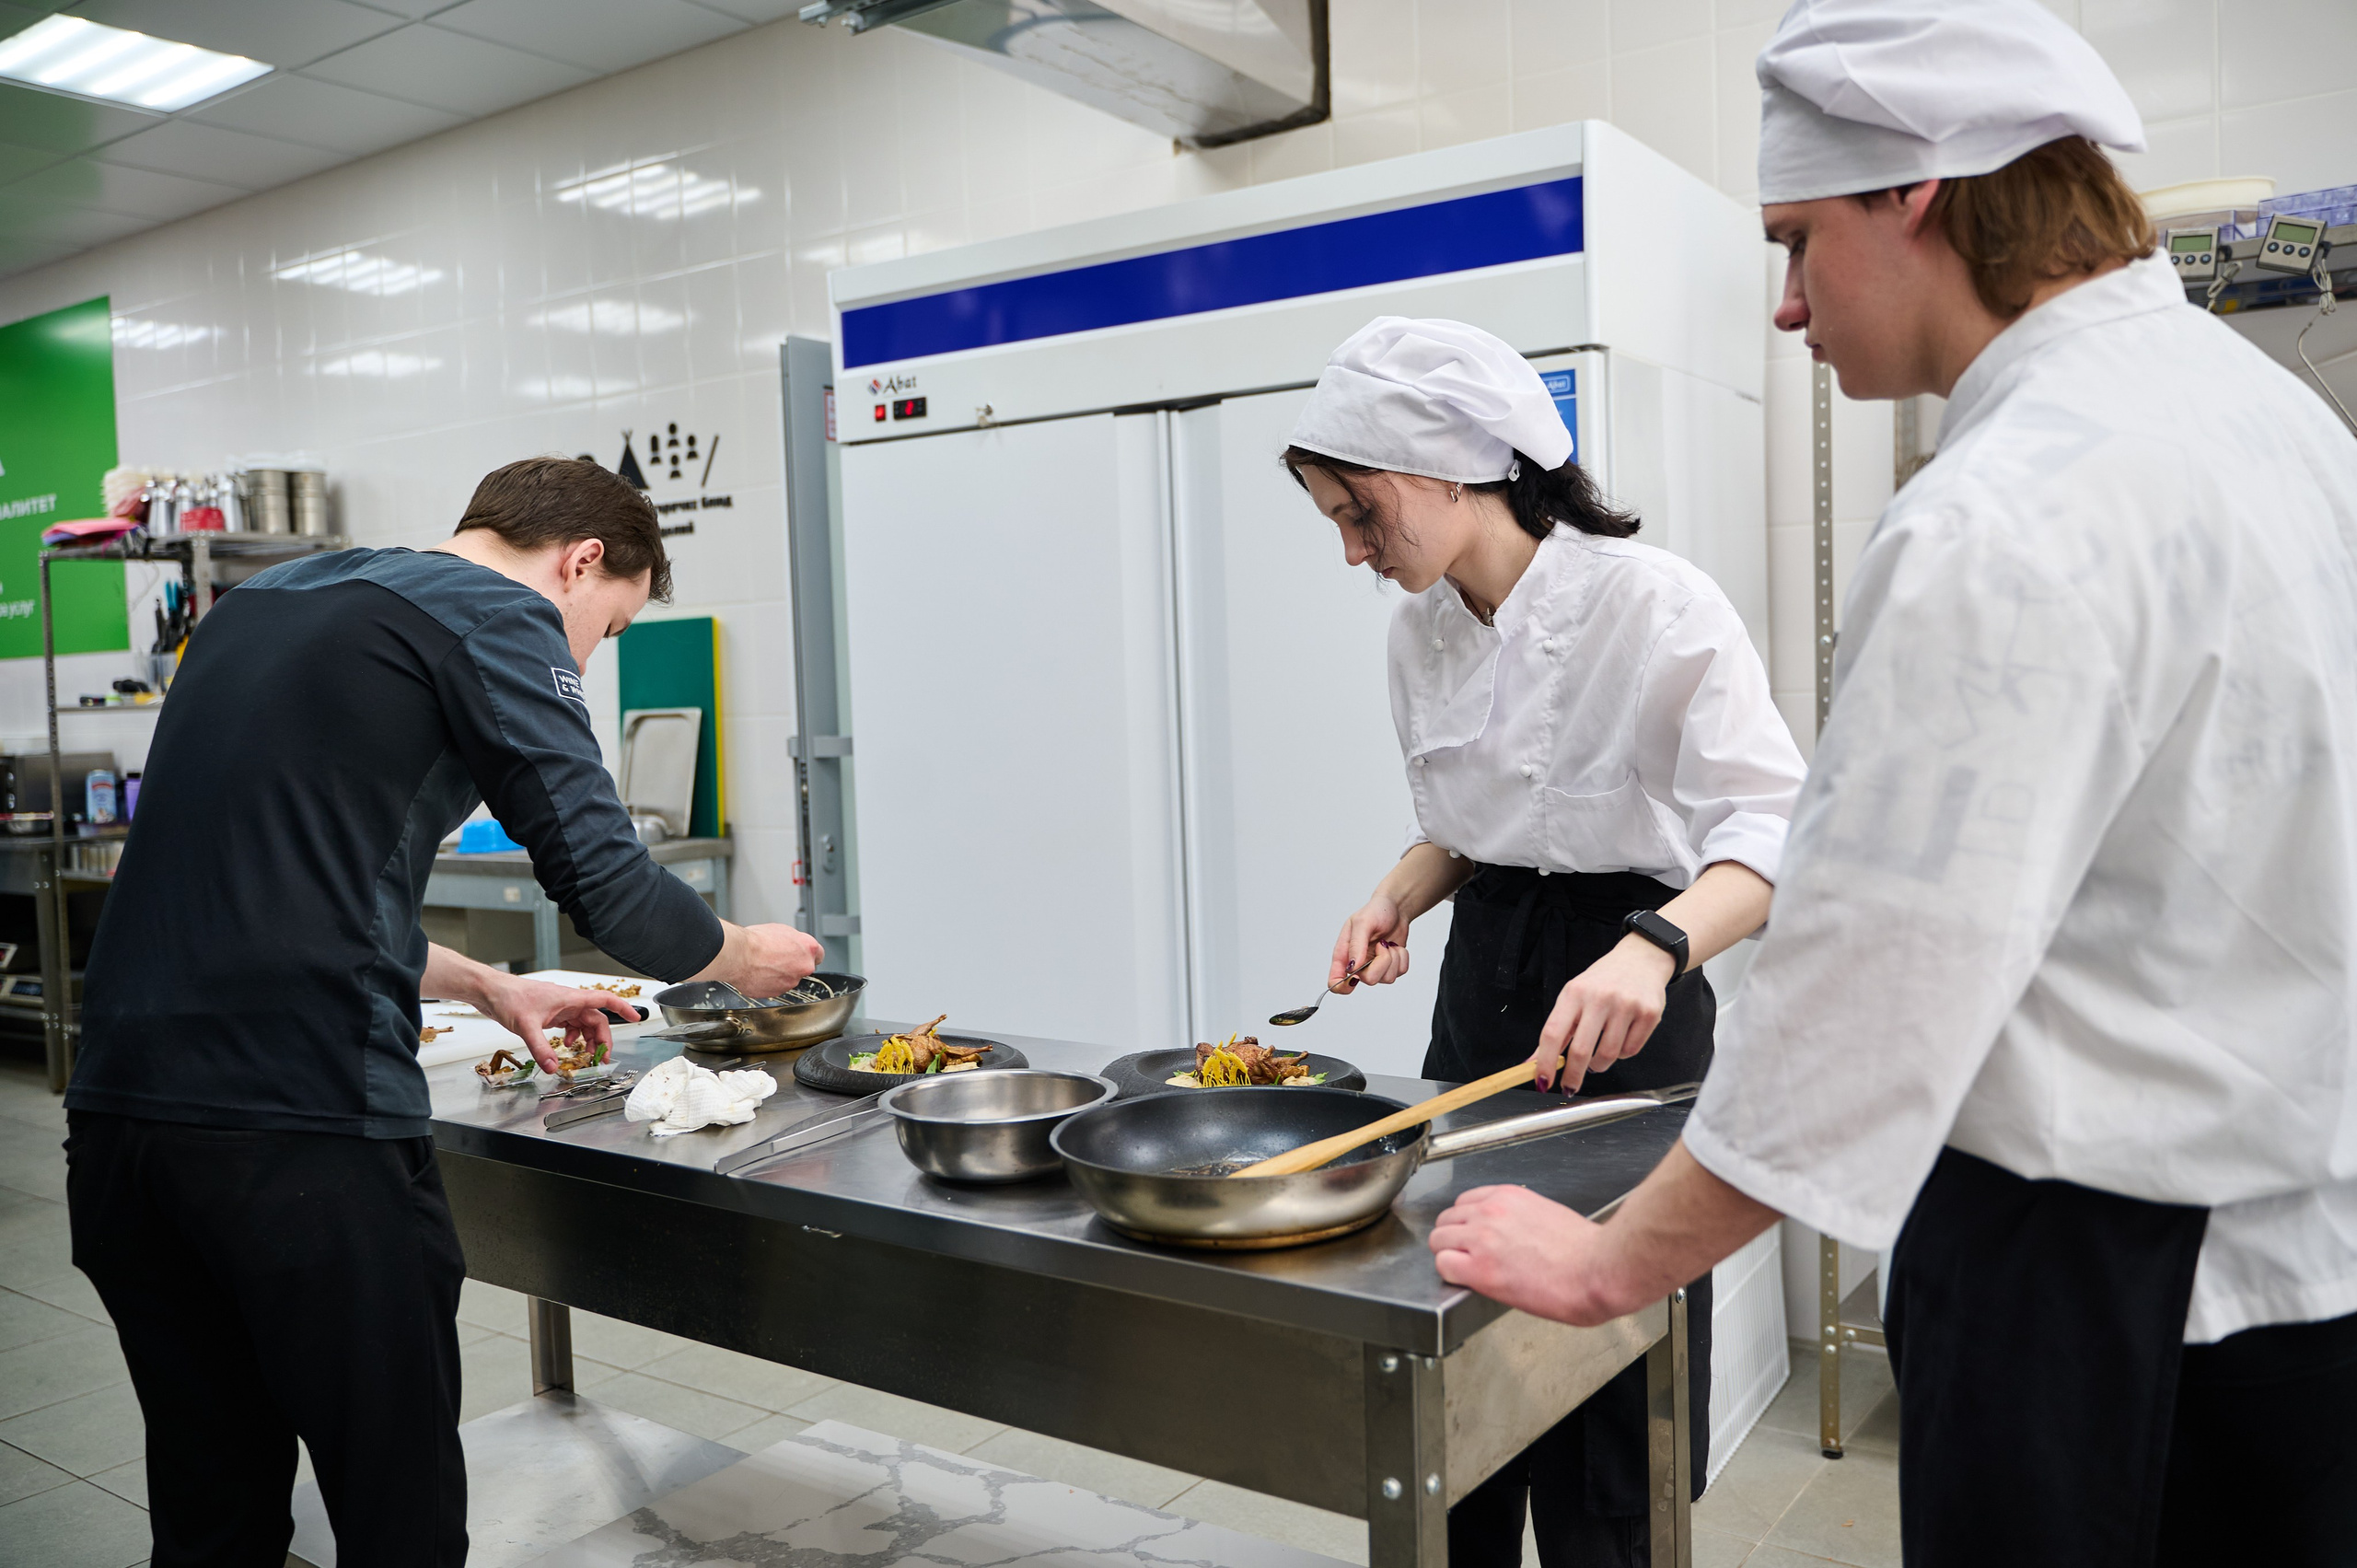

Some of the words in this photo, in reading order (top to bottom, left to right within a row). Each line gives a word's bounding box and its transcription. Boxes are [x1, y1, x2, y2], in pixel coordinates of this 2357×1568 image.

[883, 376, 917, 394] Abat
[558, 675, 580, 688] WINE
[562, 683, 570, 692] &
